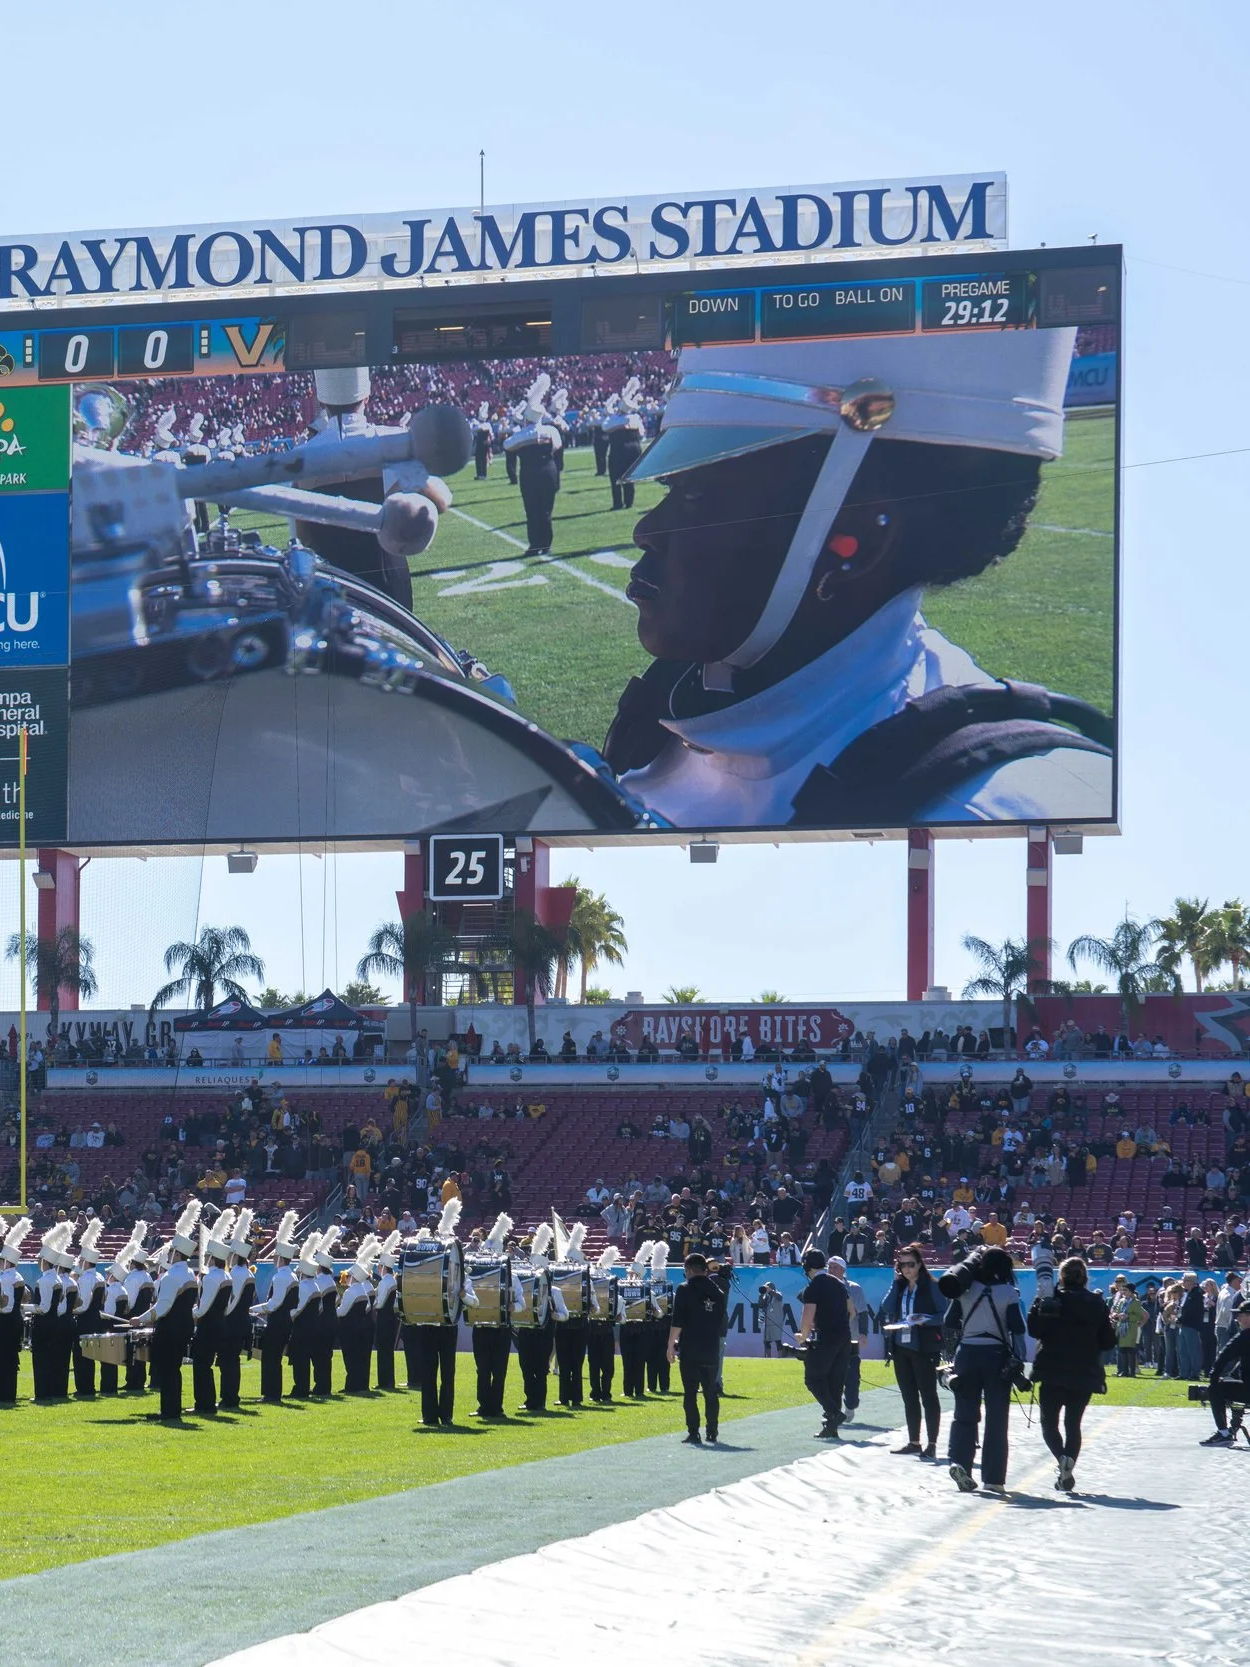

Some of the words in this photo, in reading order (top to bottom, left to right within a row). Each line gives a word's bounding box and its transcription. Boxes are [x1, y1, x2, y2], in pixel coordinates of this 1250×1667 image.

[380, 204, 631, 278] JAMES
[648, 181, 995, 260] STADIUM
[942, 280, 1010, 297] PREGAME
[773, 294, 794, 308] TO
[798, 293, 820, 307] GO
[835, 289, 876, 305] BALL
[880, 287, 904, 302] ON
[689, 298, 739, 314] DOWN
[941, 298, 1008, 325] 29:12
[64, 334, 89, 373] 0
[143, 330, 169, 369] 0
[0, 473, 27, 485] PARK
[13, 638, 40, 650] here.
[444, 851, 486, 885] 25
[759, 1015, 822, 1043] BITES
[905, 1103, 915, 1113] 10
[416, 1179, 427, 1189] 90
[852, 1188, 865, 1199] 48
[1163, 1222, 1173, 1231] 21
[670, 1231, 681, 1242] 95
[711, 1238, 723, 1248] 95
